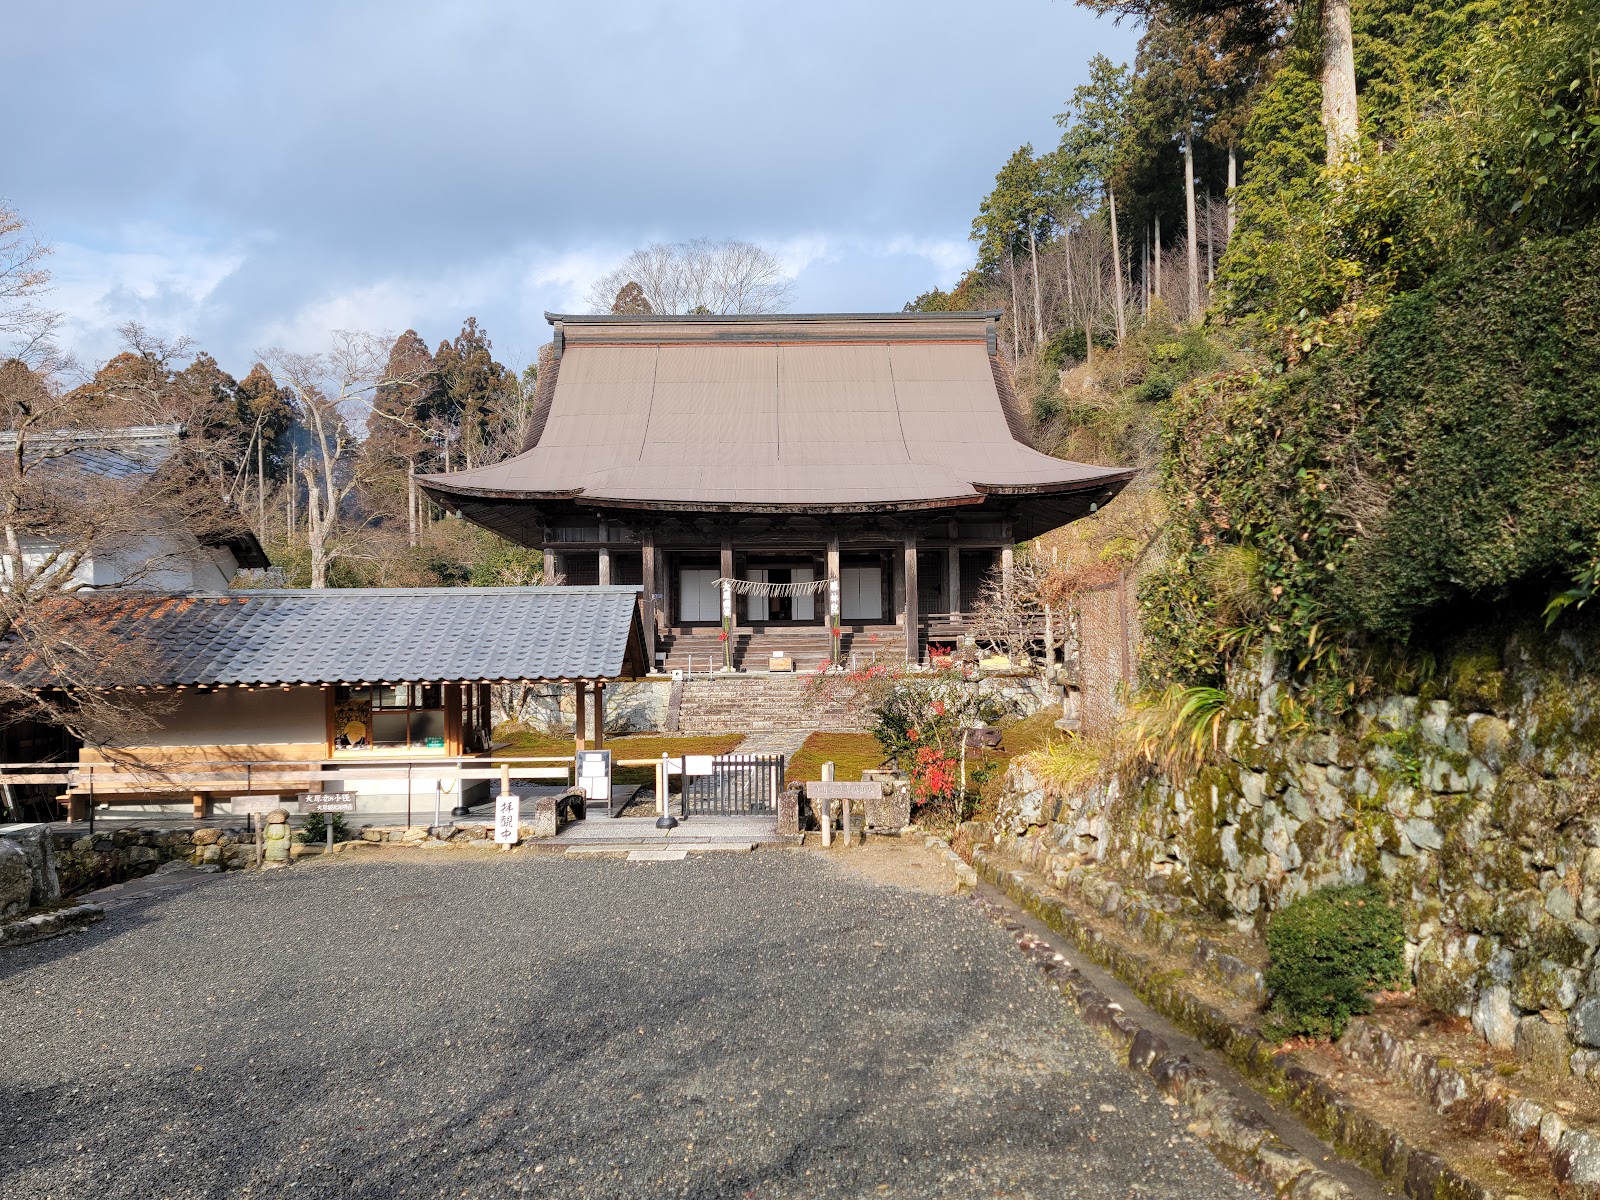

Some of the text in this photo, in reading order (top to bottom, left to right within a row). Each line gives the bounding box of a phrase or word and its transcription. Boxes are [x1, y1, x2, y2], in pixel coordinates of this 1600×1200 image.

[305, 793, 351, 802] 大原女の小径
[500, 801, 513, 841] 拝観中
